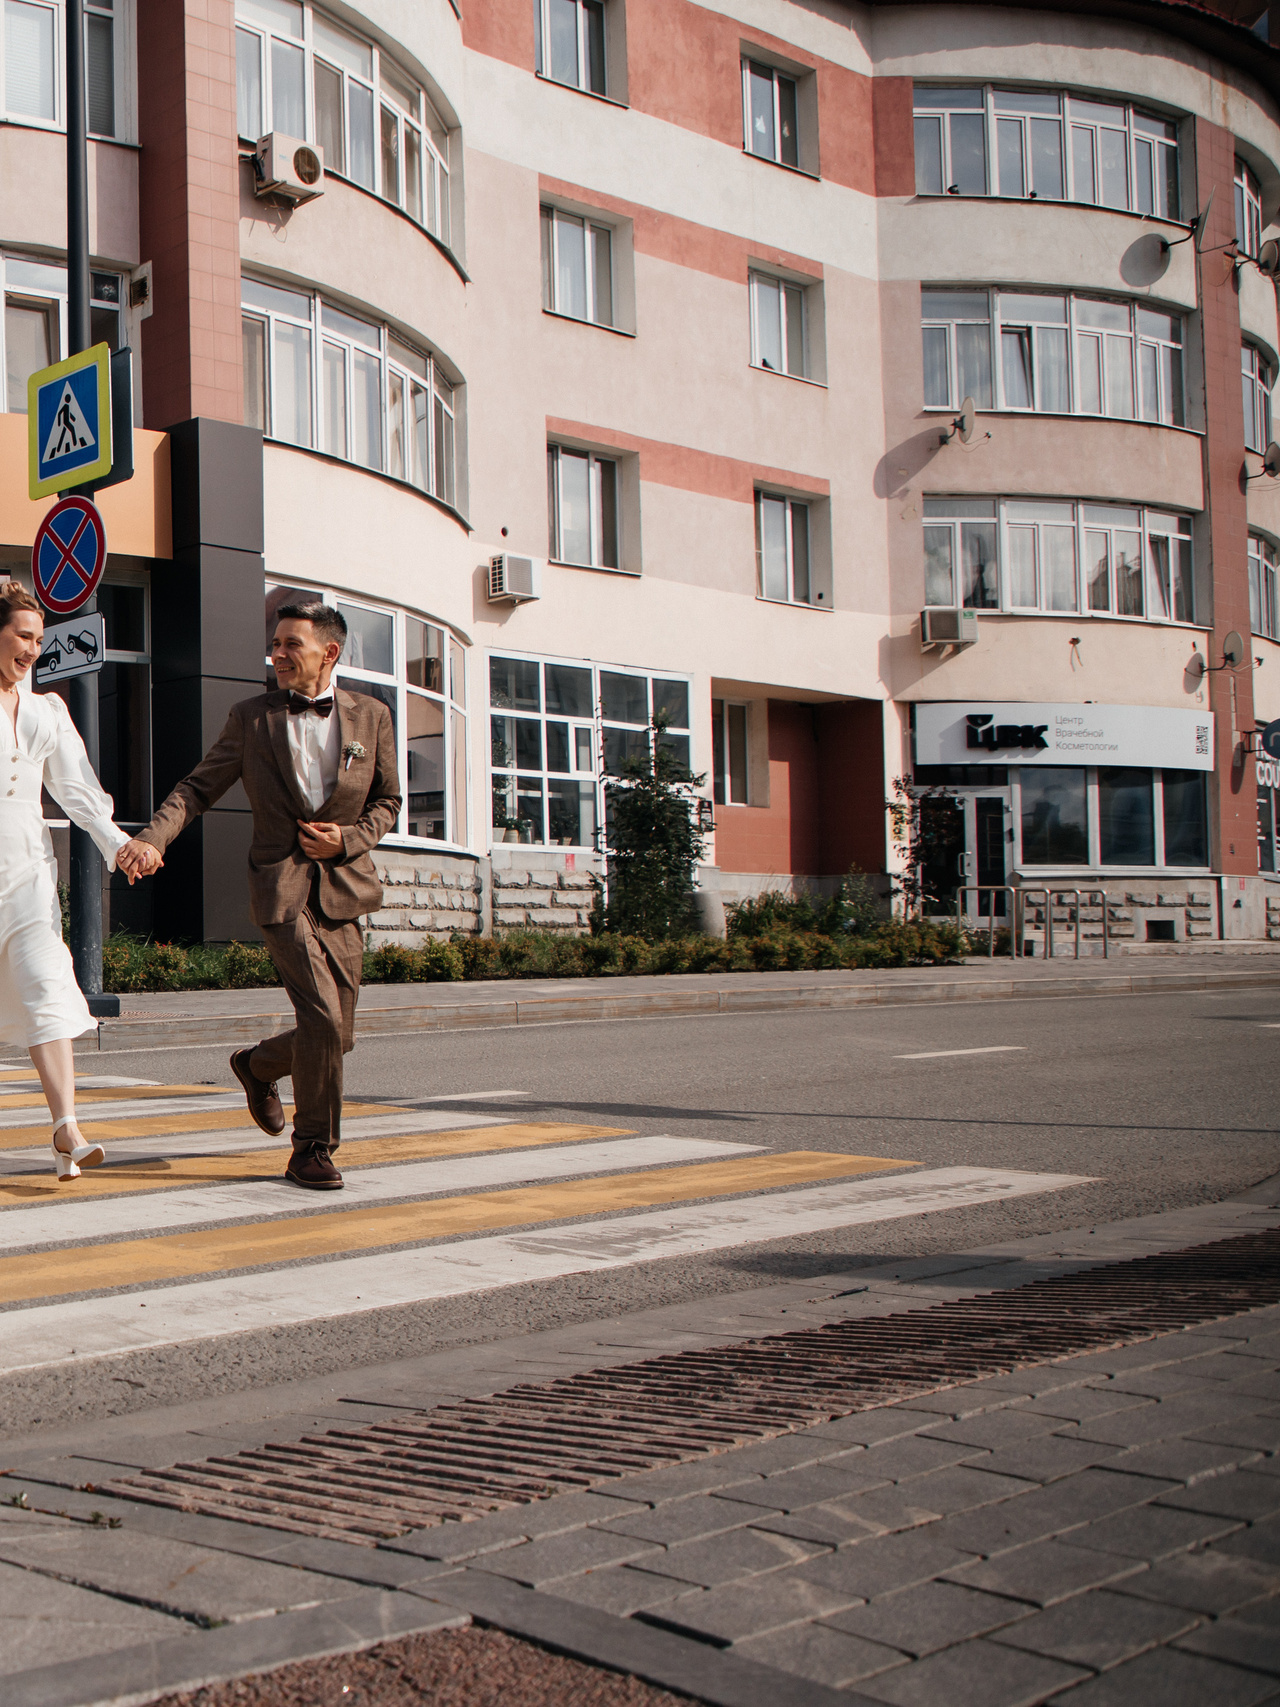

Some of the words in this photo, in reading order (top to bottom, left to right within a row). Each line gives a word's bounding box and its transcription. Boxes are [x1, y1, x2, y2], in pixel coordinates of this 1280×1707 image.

[1055, 715, 1084, 726] Центр
[1055, 727, 1104, 739] Врачебной
[1055, 739, 1119, 752] Косметологии
